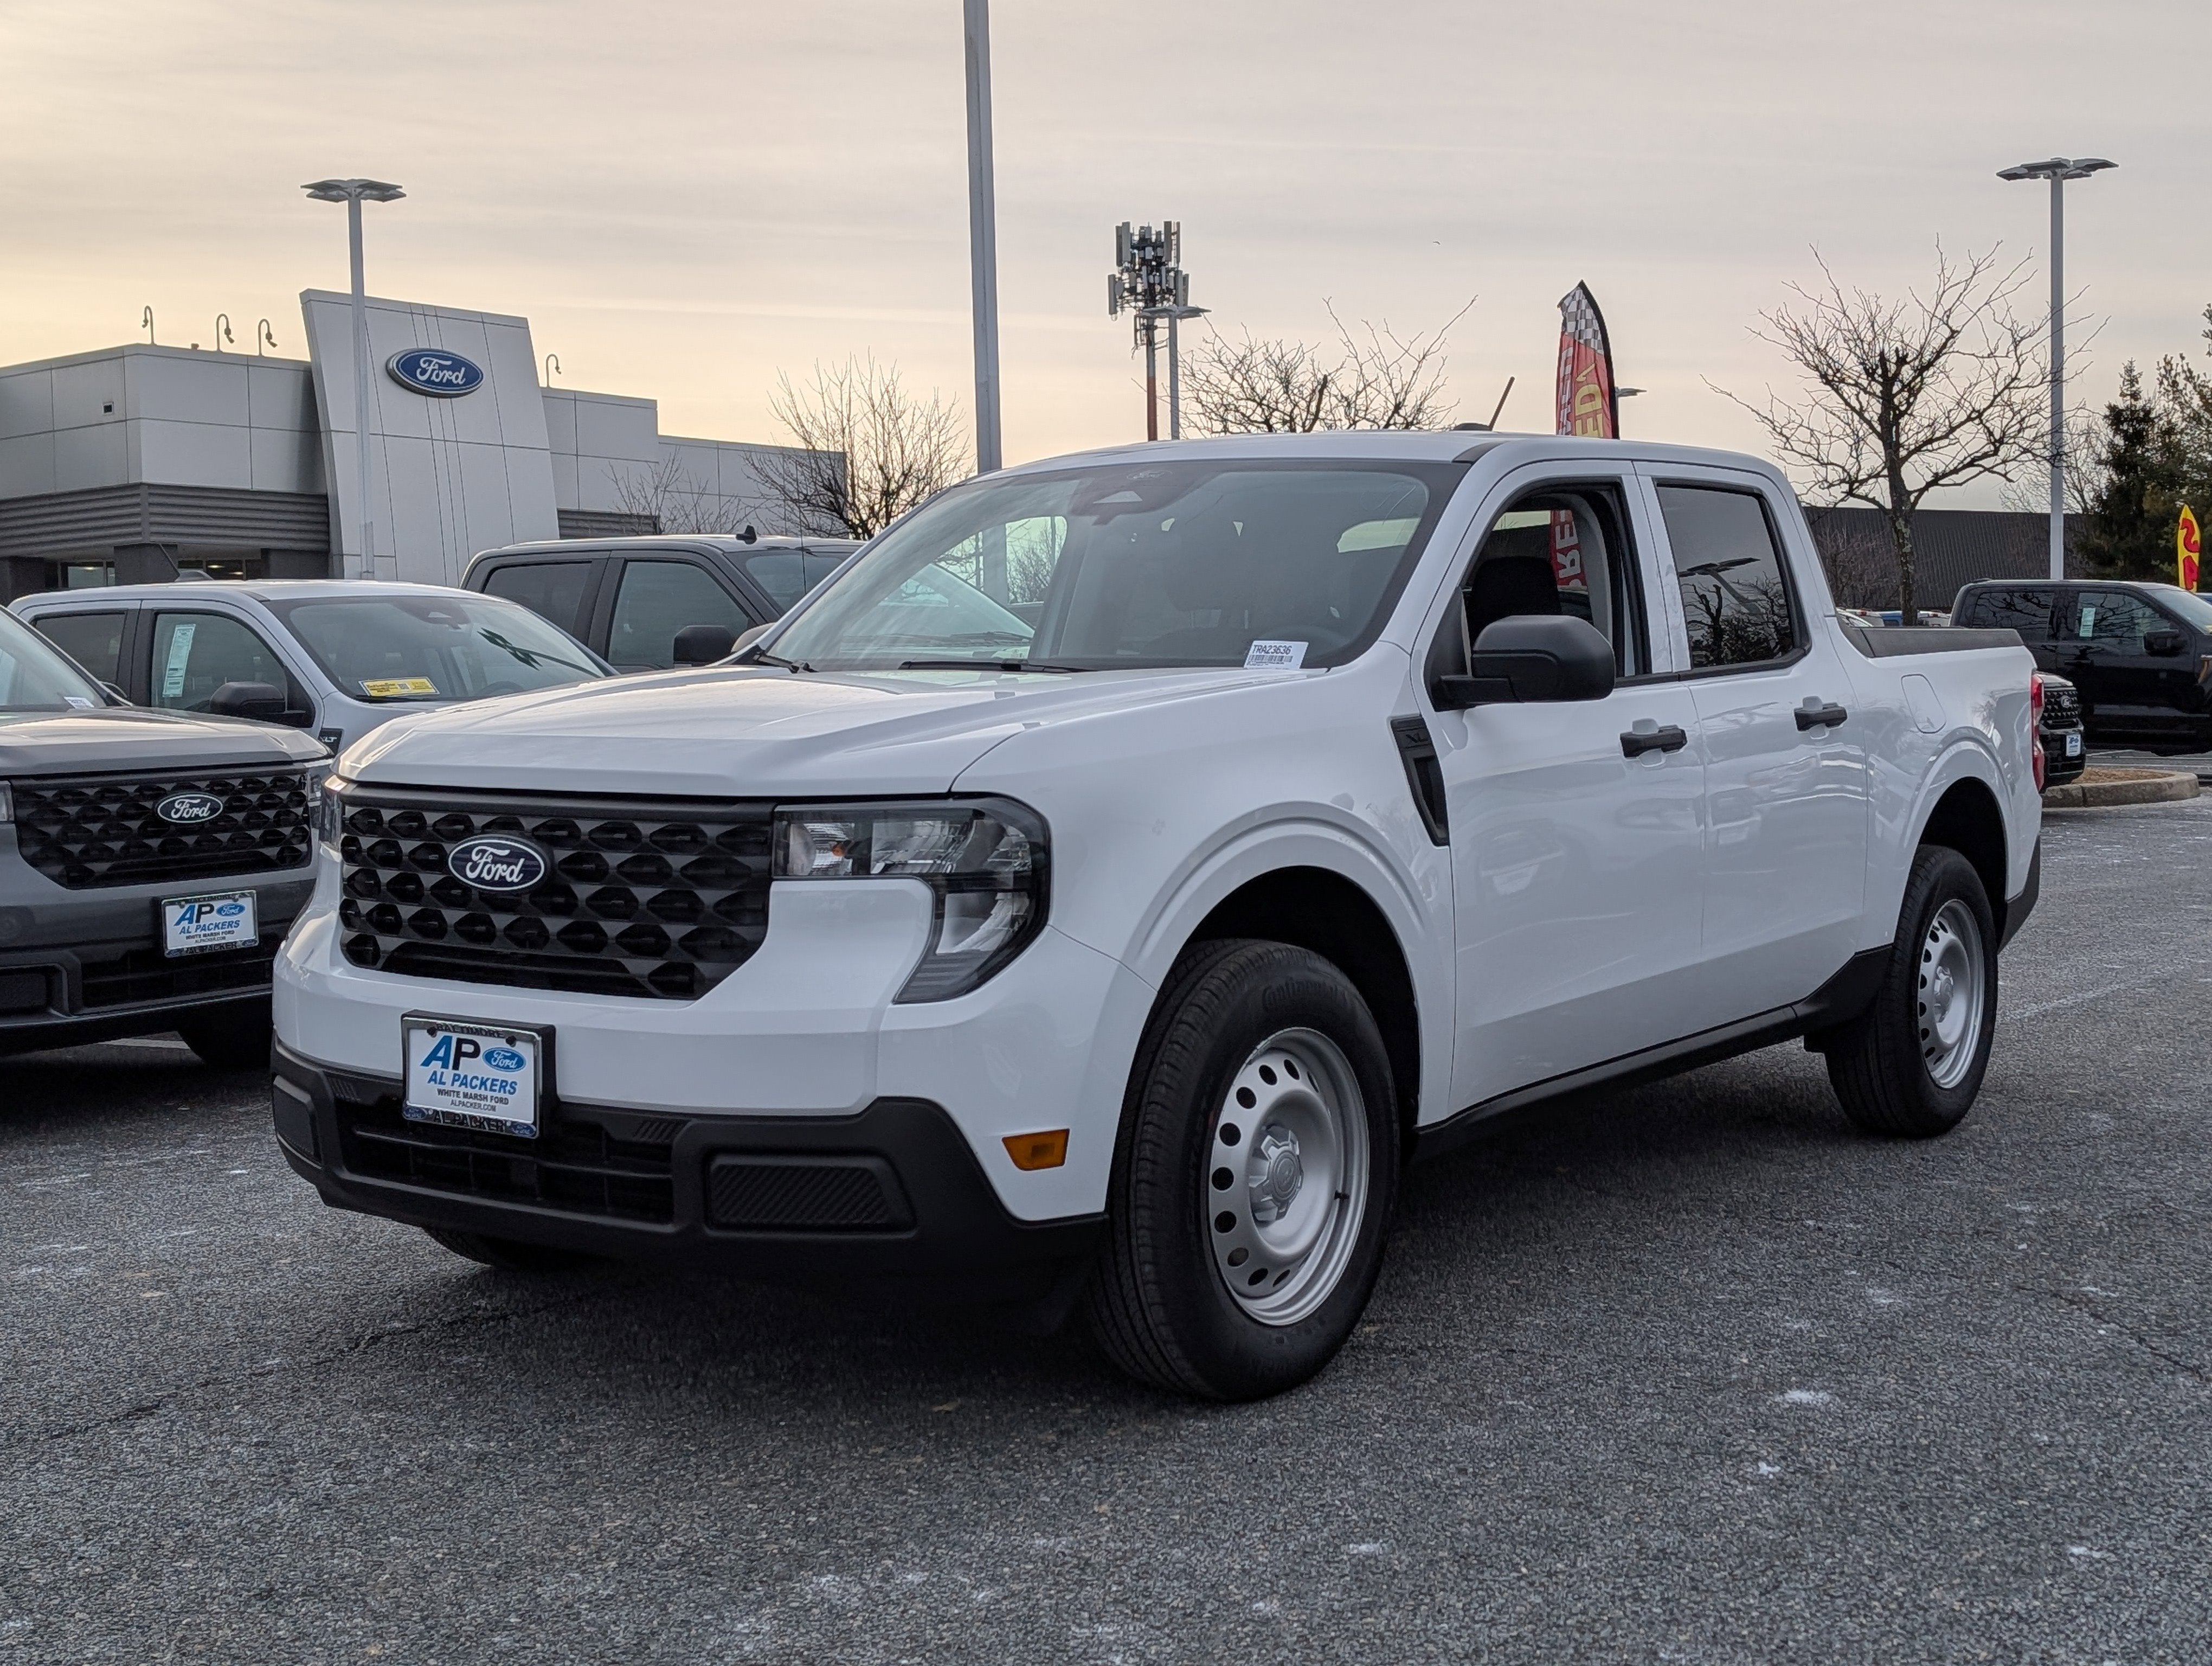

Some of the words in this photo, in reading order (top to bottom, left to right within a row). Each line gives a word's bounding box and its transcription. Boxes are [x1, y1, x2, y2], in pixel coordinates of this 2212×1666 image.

[416, 357, 466, 385] Ford
[1252, 645, 1293, 655] TRA23636
[171, 799, 210, 818] Ford
[466, 845, 525, 882] Ford
[173, 903, 215, 926] AP
[221, 905, 240, 915] Ford
[179, 925, 192, 934] AL
[195, 920, 240, 933] PACKERS
[420, 1035, 481, 1071] AP
[491, 1050, 518, 1068] Ford
[427, 1070, 446, 1085] AL
[451, 1073, 518, 1095] PACKERS
[436, 1088, 461, 1098] WHITE
[462, 1091, 488, 1102] MARSH
[490, 1095, 509, 1105] FORD
[451, 1099, 497, 1112] ALPACKER.COM
[454, 1113, 506, 1133] PACKER
